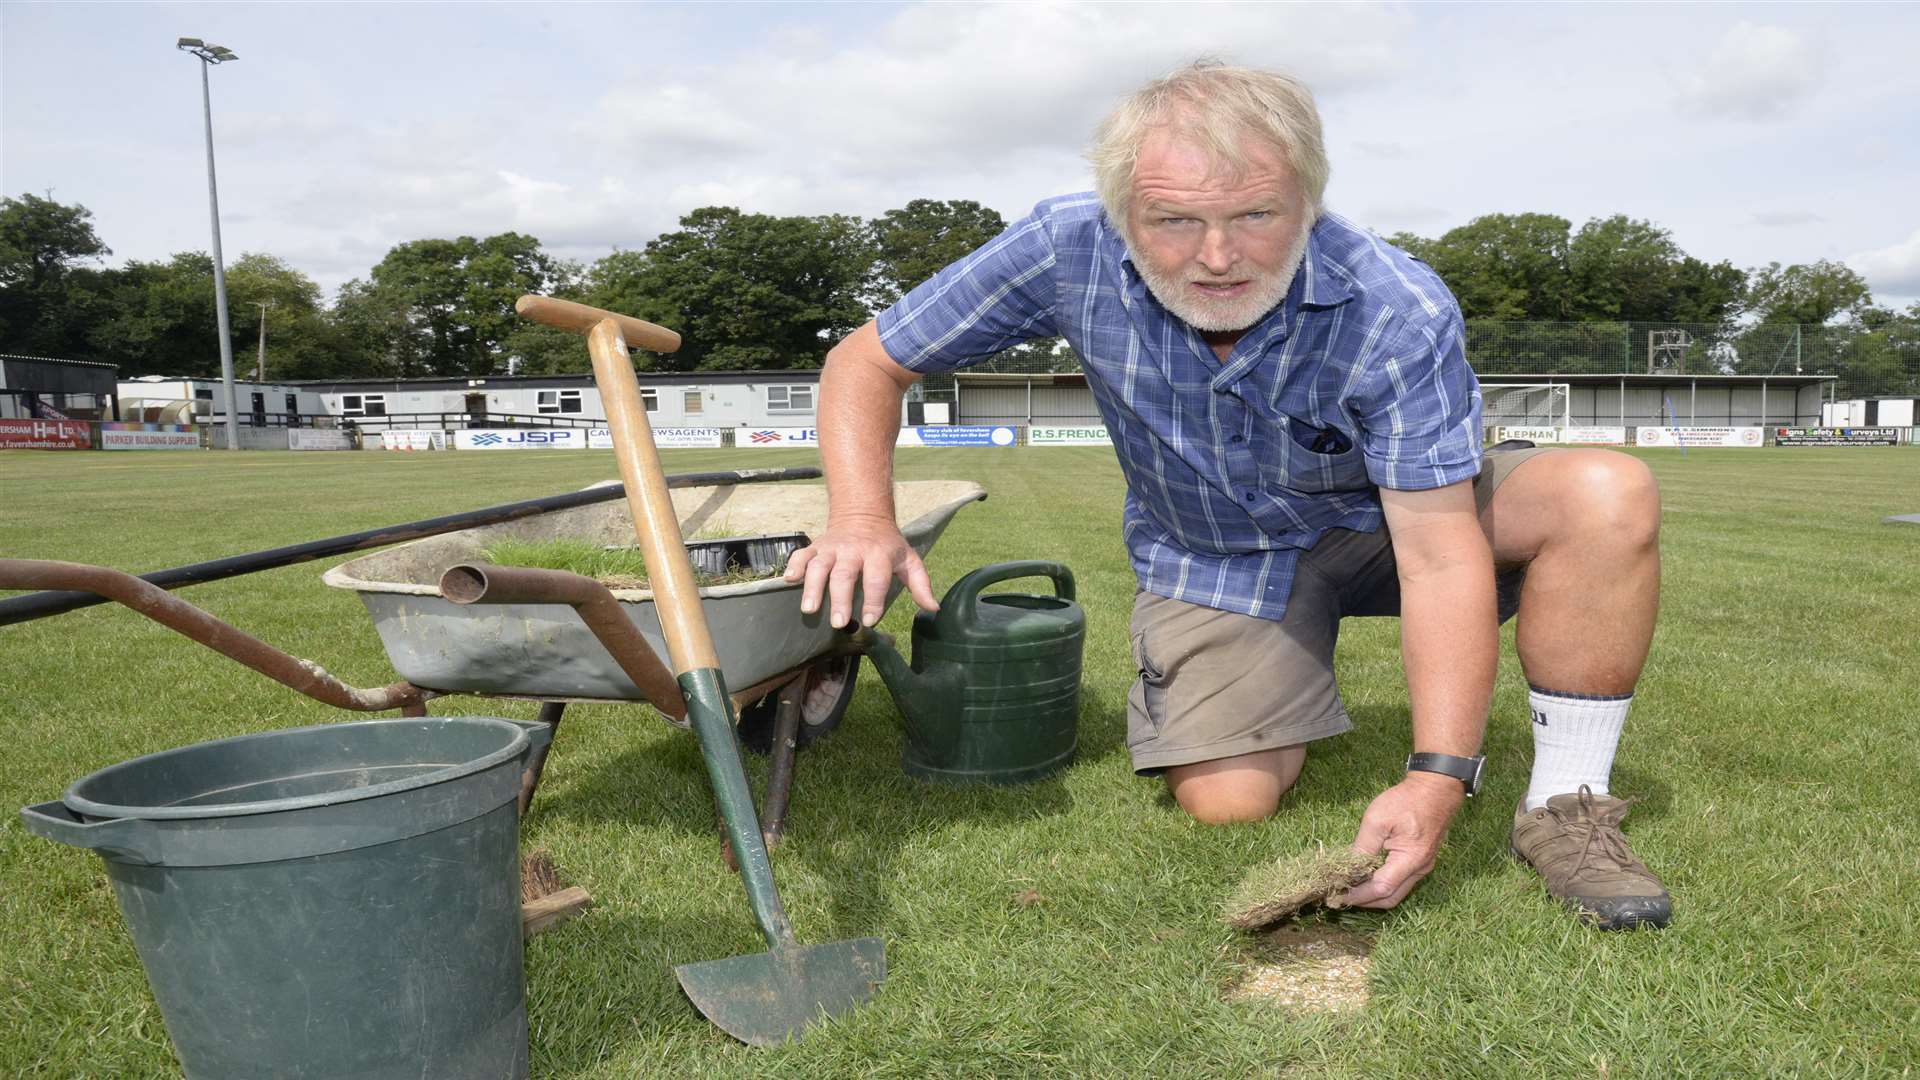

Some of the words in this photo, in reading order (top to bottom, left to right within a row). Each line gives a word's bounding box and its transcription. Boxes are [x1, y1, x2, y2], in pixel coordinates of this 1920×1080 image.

[507, 431, 571, 443] JSP
[650, 429, 720, 437] EWSAGENTS
[1032, 429, 1109, 438] R.S.FRENC
[1498, 426, 1562, 442] ELEPHANT
[1779, 428, 1804, 437] Signs
[1807, 428, 1833, 437] Safety
[1835, 428, 1842, 436] &
[1843, 428, 1879, 438] Surveys
[106, 435, 132, 445] PARKER
[135, 435, 167, 445] BUILDING
[168, 435, 198, 446] SUPPLIES
